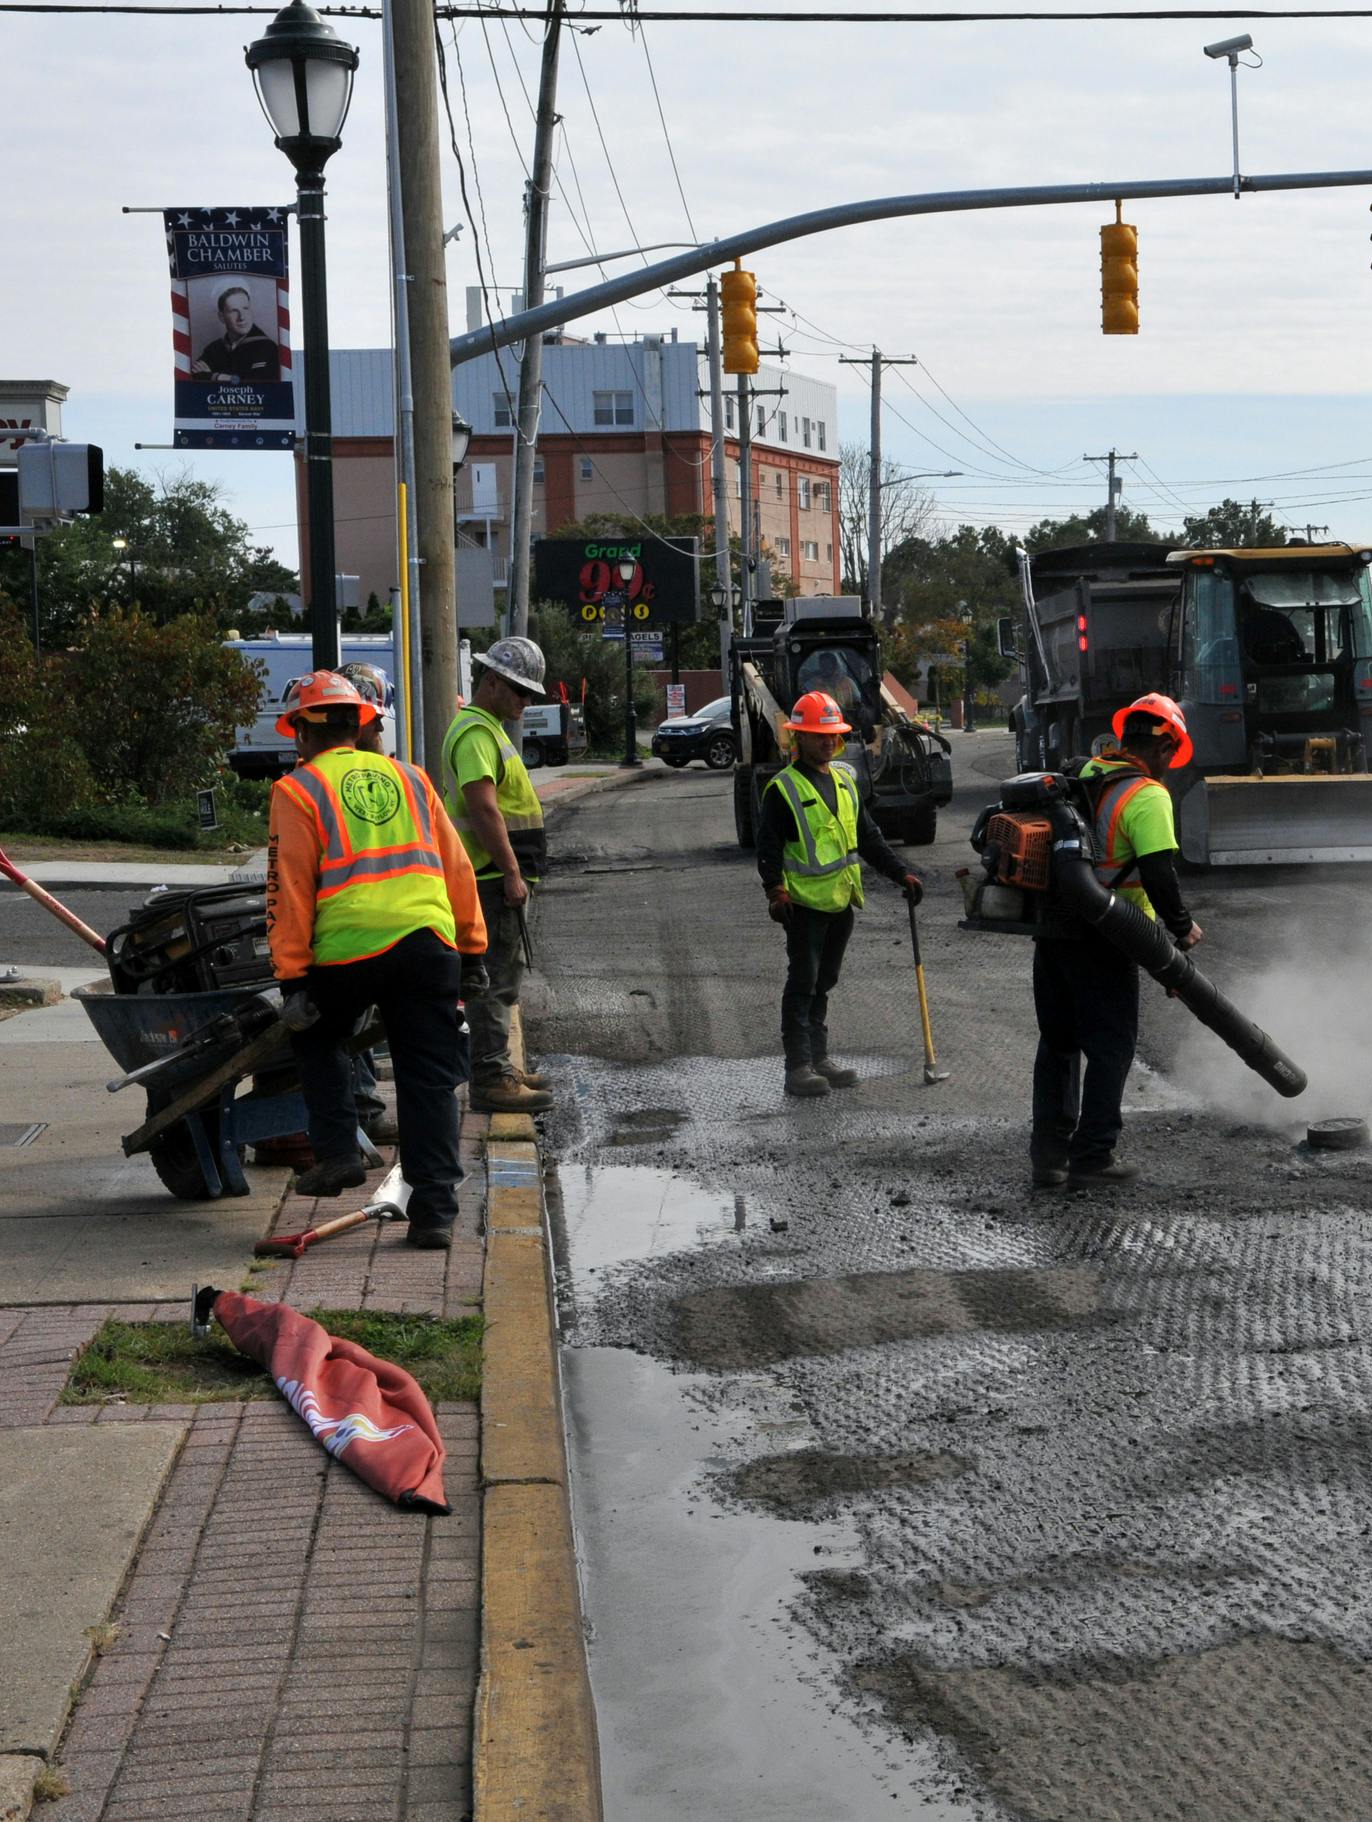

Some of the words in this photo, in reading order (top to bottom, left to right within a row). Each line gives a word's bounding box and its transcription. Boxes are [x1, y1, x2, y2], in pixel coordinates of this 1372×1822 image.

[188, 233, 270, 248] BALDWIN
[187, 248, 274, 263] CHAMBER
[213, 261, 248, 271] SALUTES
[218, 385, 254, 395] Joseph
[207, 393, 265, 406] CARNEY
[584, 543, 642, 558] Grand
[267, 834, 279, 893] METRO
